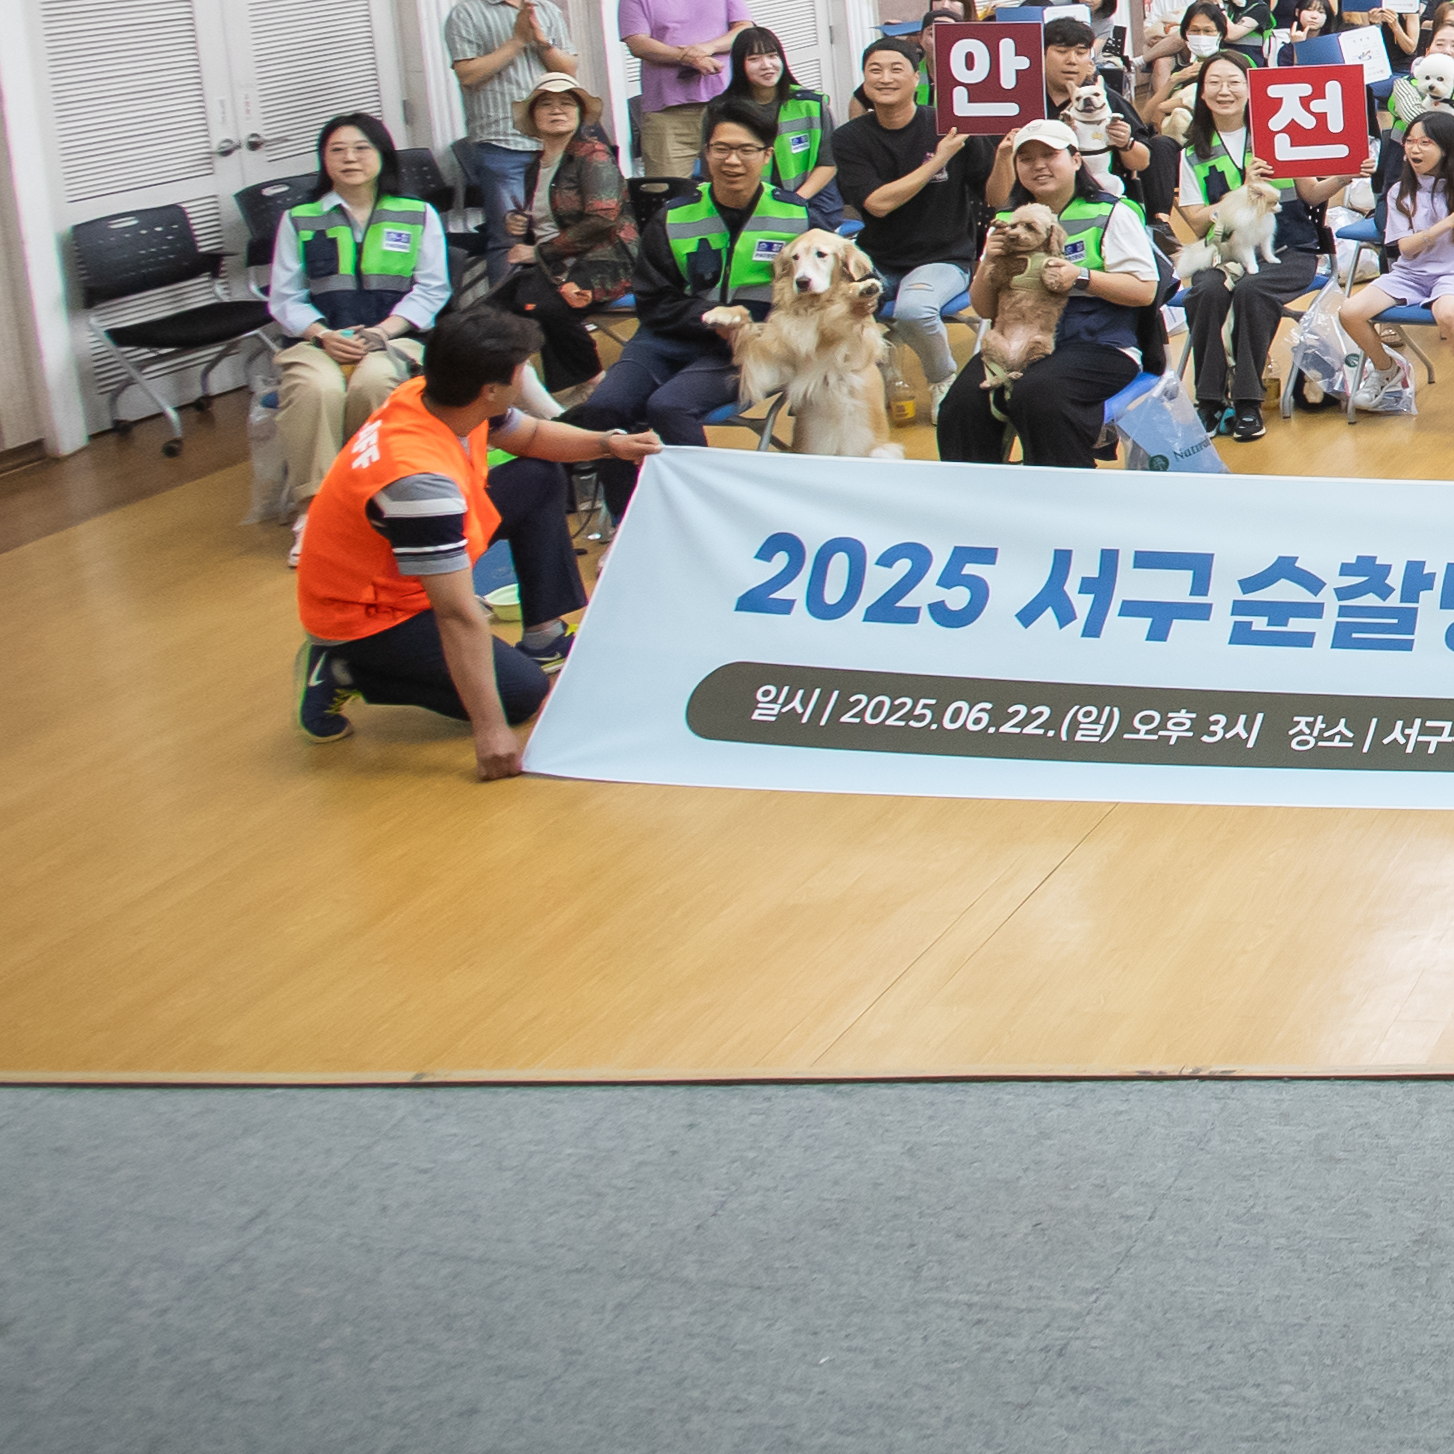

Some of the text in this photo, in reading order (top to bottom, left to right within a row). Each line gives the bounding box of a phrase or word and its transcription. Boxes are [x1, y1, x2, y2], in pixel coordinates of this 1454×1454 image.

[950, 37, 1031, 117] 안
[1266, 80, 1350, 161] 전
[734, 531, 999, 630] 2025
[751, 685, 821, 724] 일시
[1122, 708, 1197, 745] 오후
[1200, 712, 1264, 749] 3시
[1288, 715, 1354, 751] 장소
